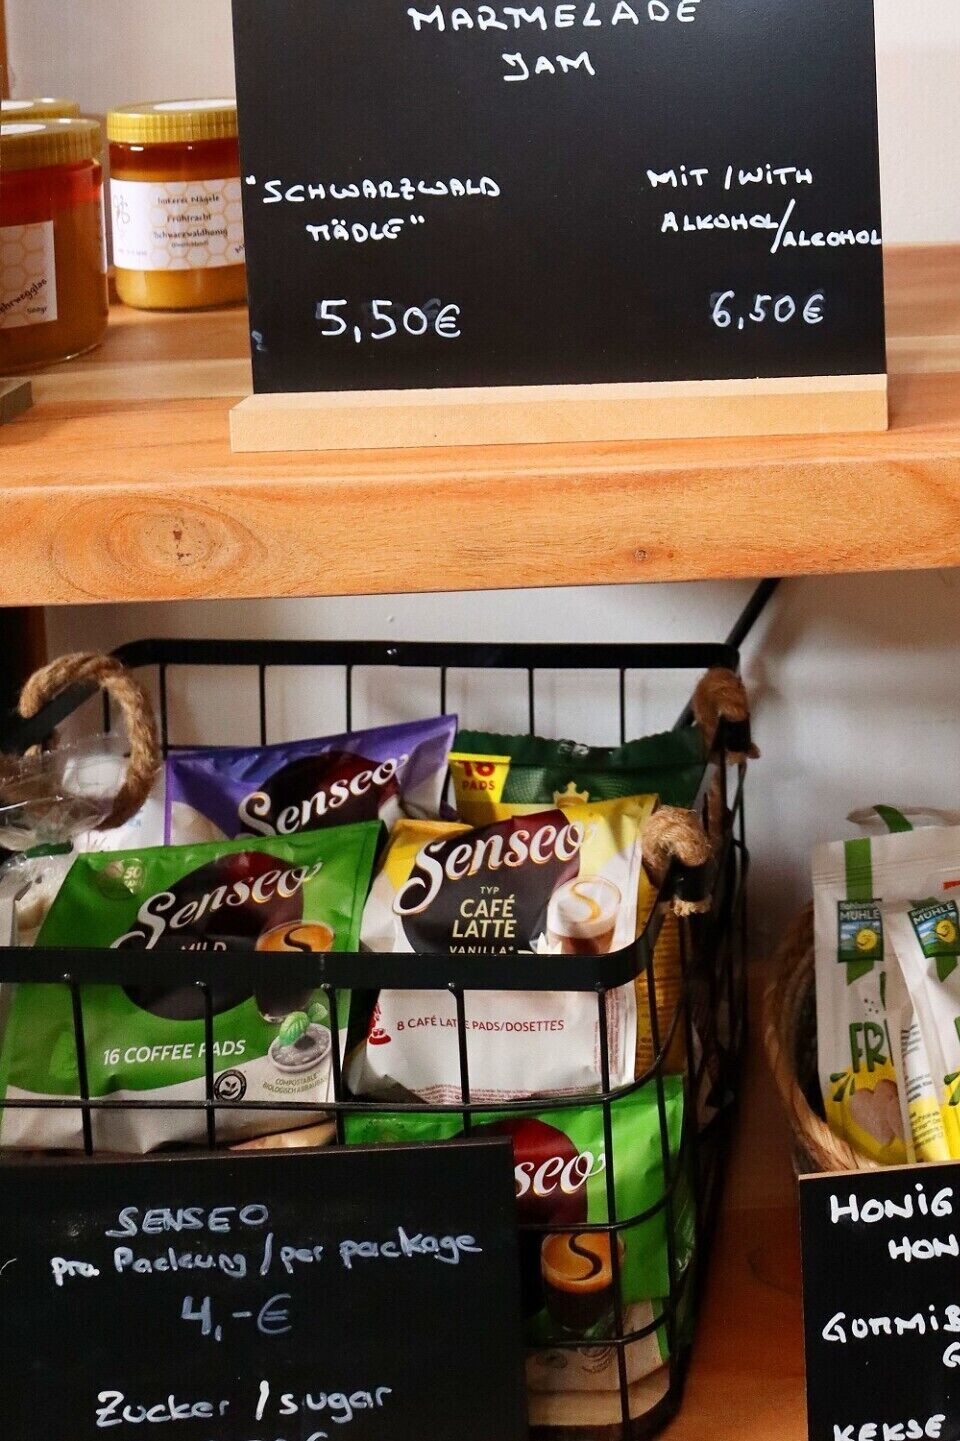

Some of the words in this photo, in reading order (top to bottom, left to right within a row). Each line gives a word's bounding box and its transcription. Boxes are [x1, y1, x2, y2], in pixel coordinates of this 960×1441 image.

[501, 52, 596, 82] JAM
[319, 297, 463, 345] 5,50€
[709, 290, 826, 331] 6,50€
[238, 752, 409, 838] Senseo
[462, 780, 496, 791] PADS
[392, 818, 598, 916] Senseo
[110, 857, 324, 950] Senseo
[459, 893, 516, 918] CAFÉ
[480, 885, 501, 895] TYP
[452, 919, 518, 939] LATTE
[408, 1015, 438, 1029] CAFÉ
[440, 1018, 471, 1031] LATE
[103, 1048, 121, 1065] 16
[124, 1042, 195, 1064] COFFEE
[515, 1151, 606, 1198] seo
[105, 1203, 269, 1239] SENSEO
[339, 1226, 484, 1268] package
[95, 1389, 230, 1429] Zucker
[833, 1413, 946, 1441] KEKSE
